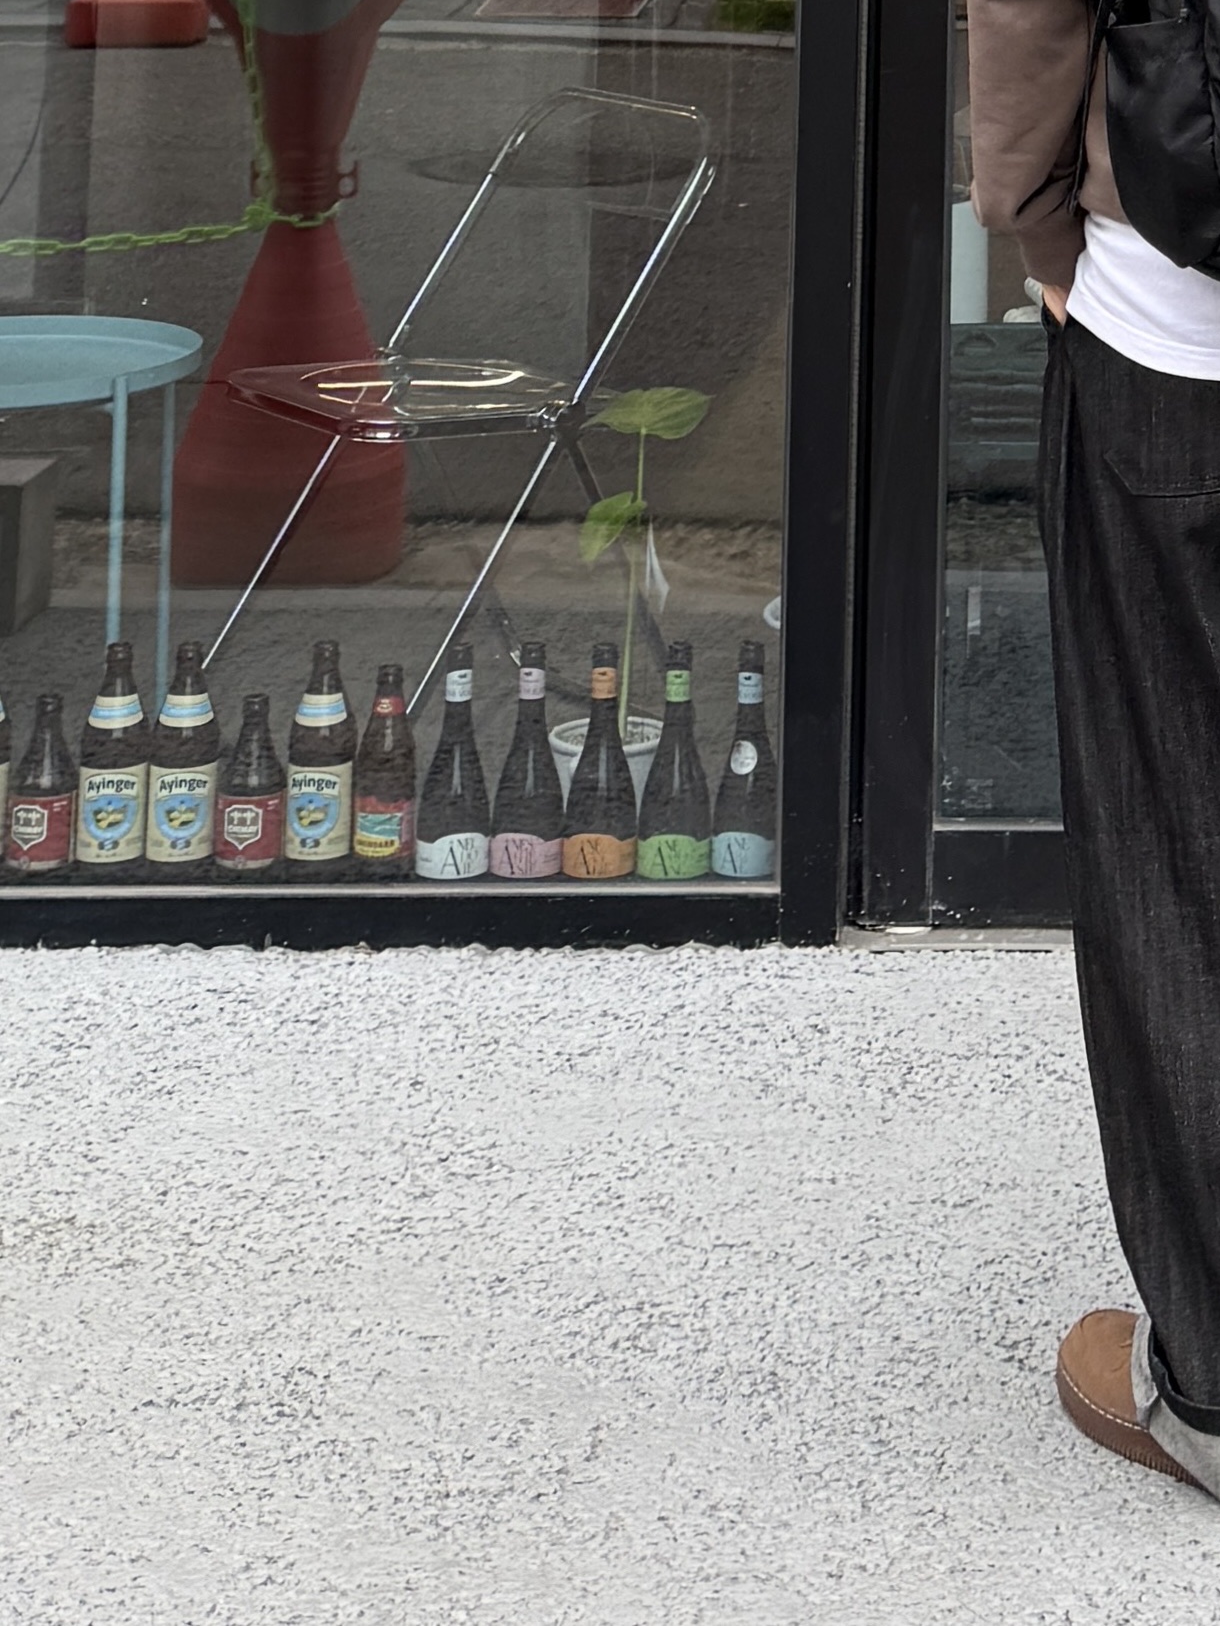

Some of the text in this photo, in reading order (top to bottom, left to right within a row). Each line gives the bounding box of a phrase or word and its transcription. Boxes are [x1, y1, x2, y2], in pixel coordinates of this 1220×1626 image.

[87, 777, 137, 794] Ayinger
[159, 776, 209, 793] Ayinger
[291, 774, 339, 792] Ayinger
